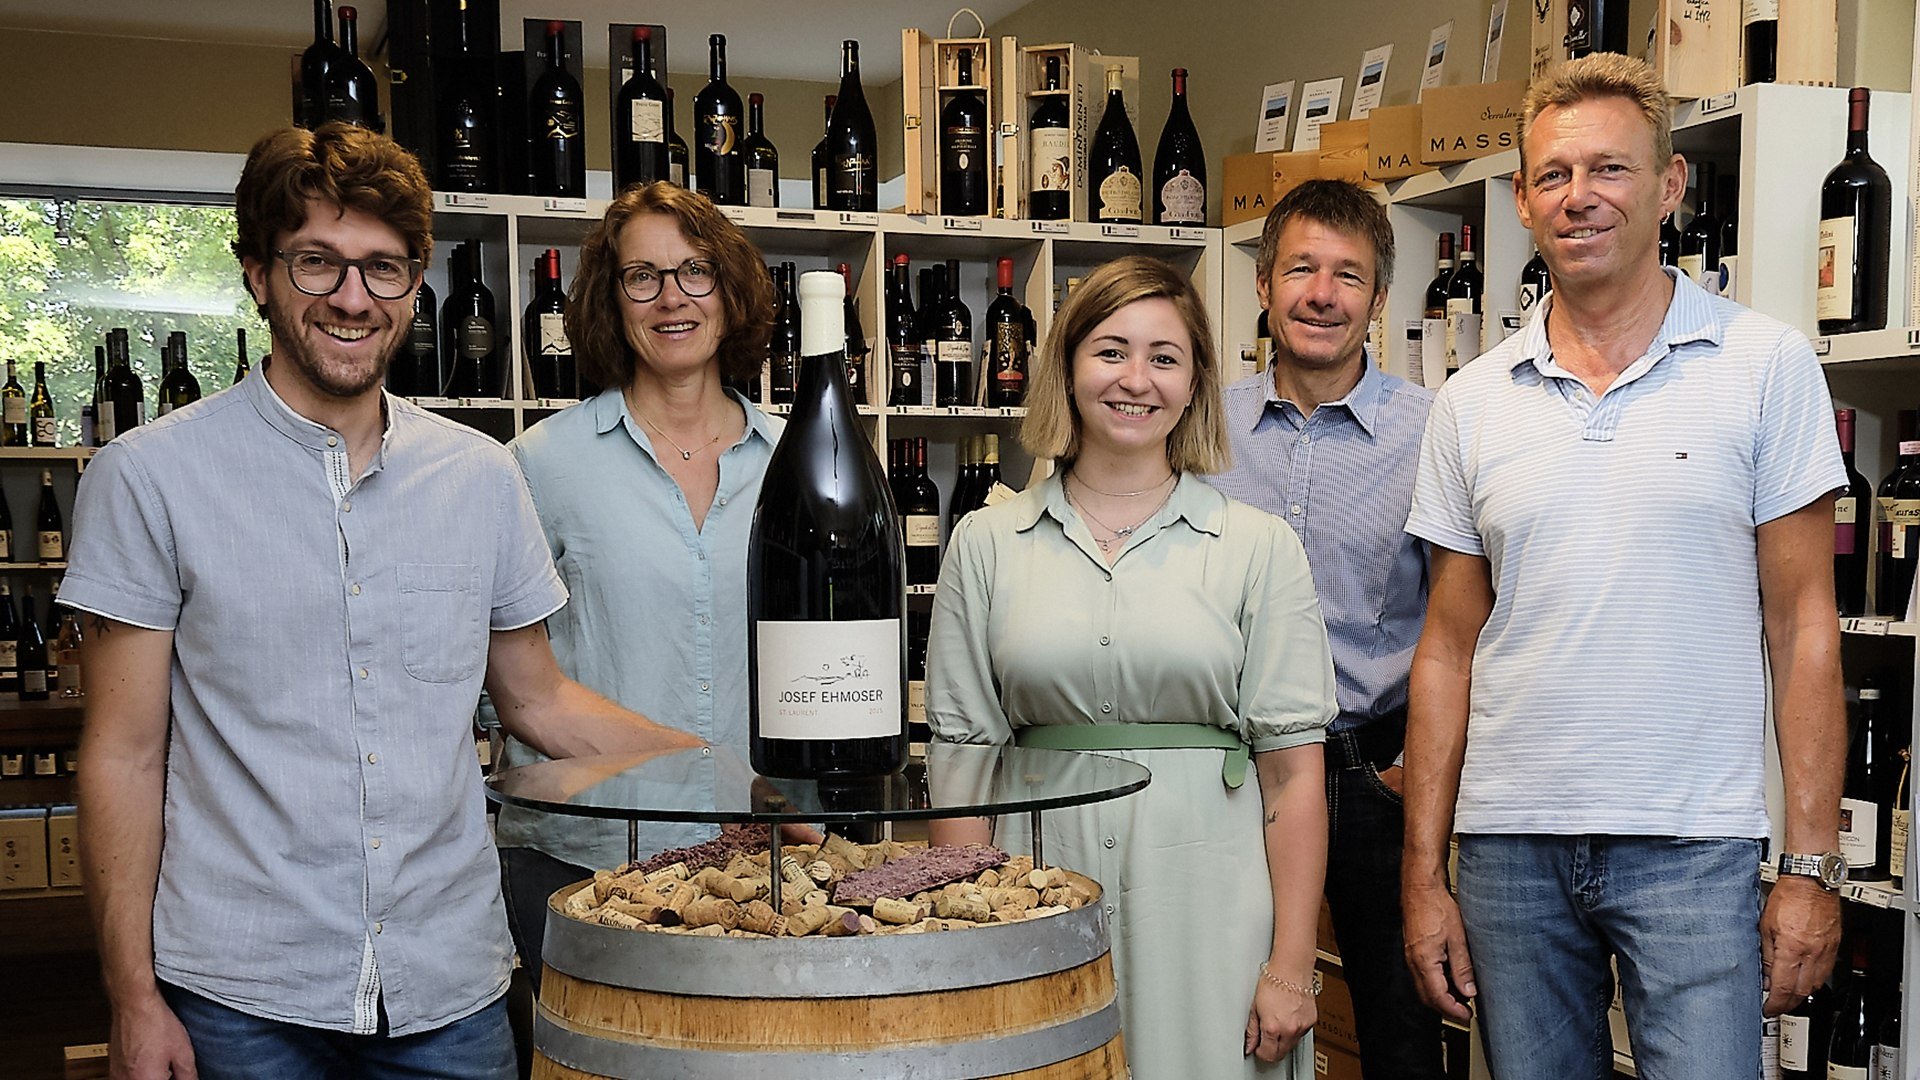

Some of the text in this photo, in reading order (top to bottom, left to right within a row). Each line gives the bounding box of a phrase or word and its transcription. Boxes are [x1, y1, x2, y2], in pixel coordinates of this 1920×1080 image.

[1480, 106, 1524, 121] Serralun
[1430, 132, 1512, 152] MASS
[778, 688, 884, 704] JOSEF EHMOSER
[788, 708, 818, 717] LAURENT
